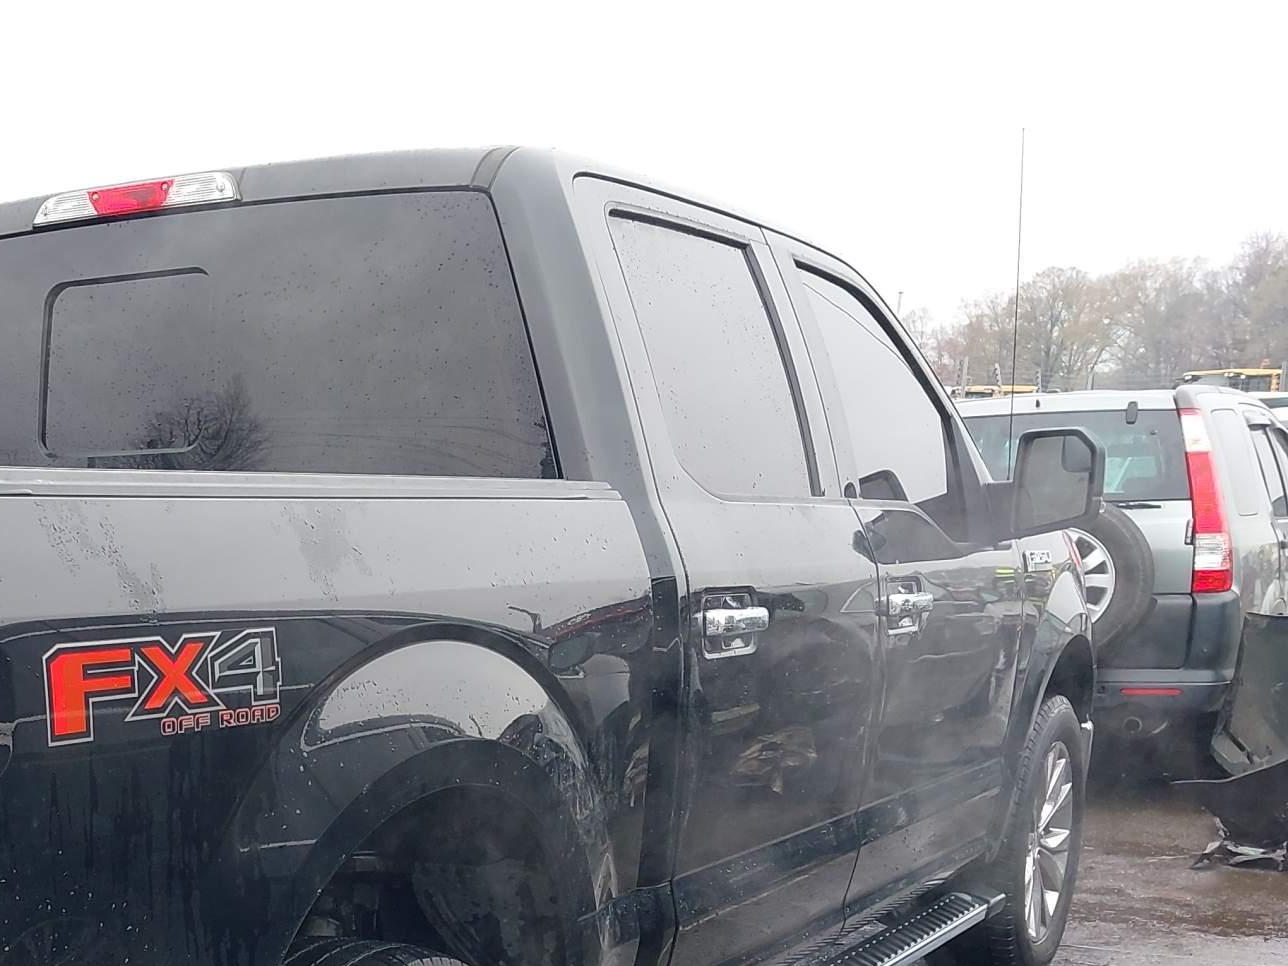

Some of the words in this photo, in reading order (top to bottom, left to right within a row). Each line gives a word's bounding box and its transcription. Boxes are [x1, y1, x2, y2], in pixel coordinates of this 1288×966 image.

[42, 627, 282, 747] FX4
[160, 716, 211, 736] OFF
[219, 704, 281, 729] ROAD
